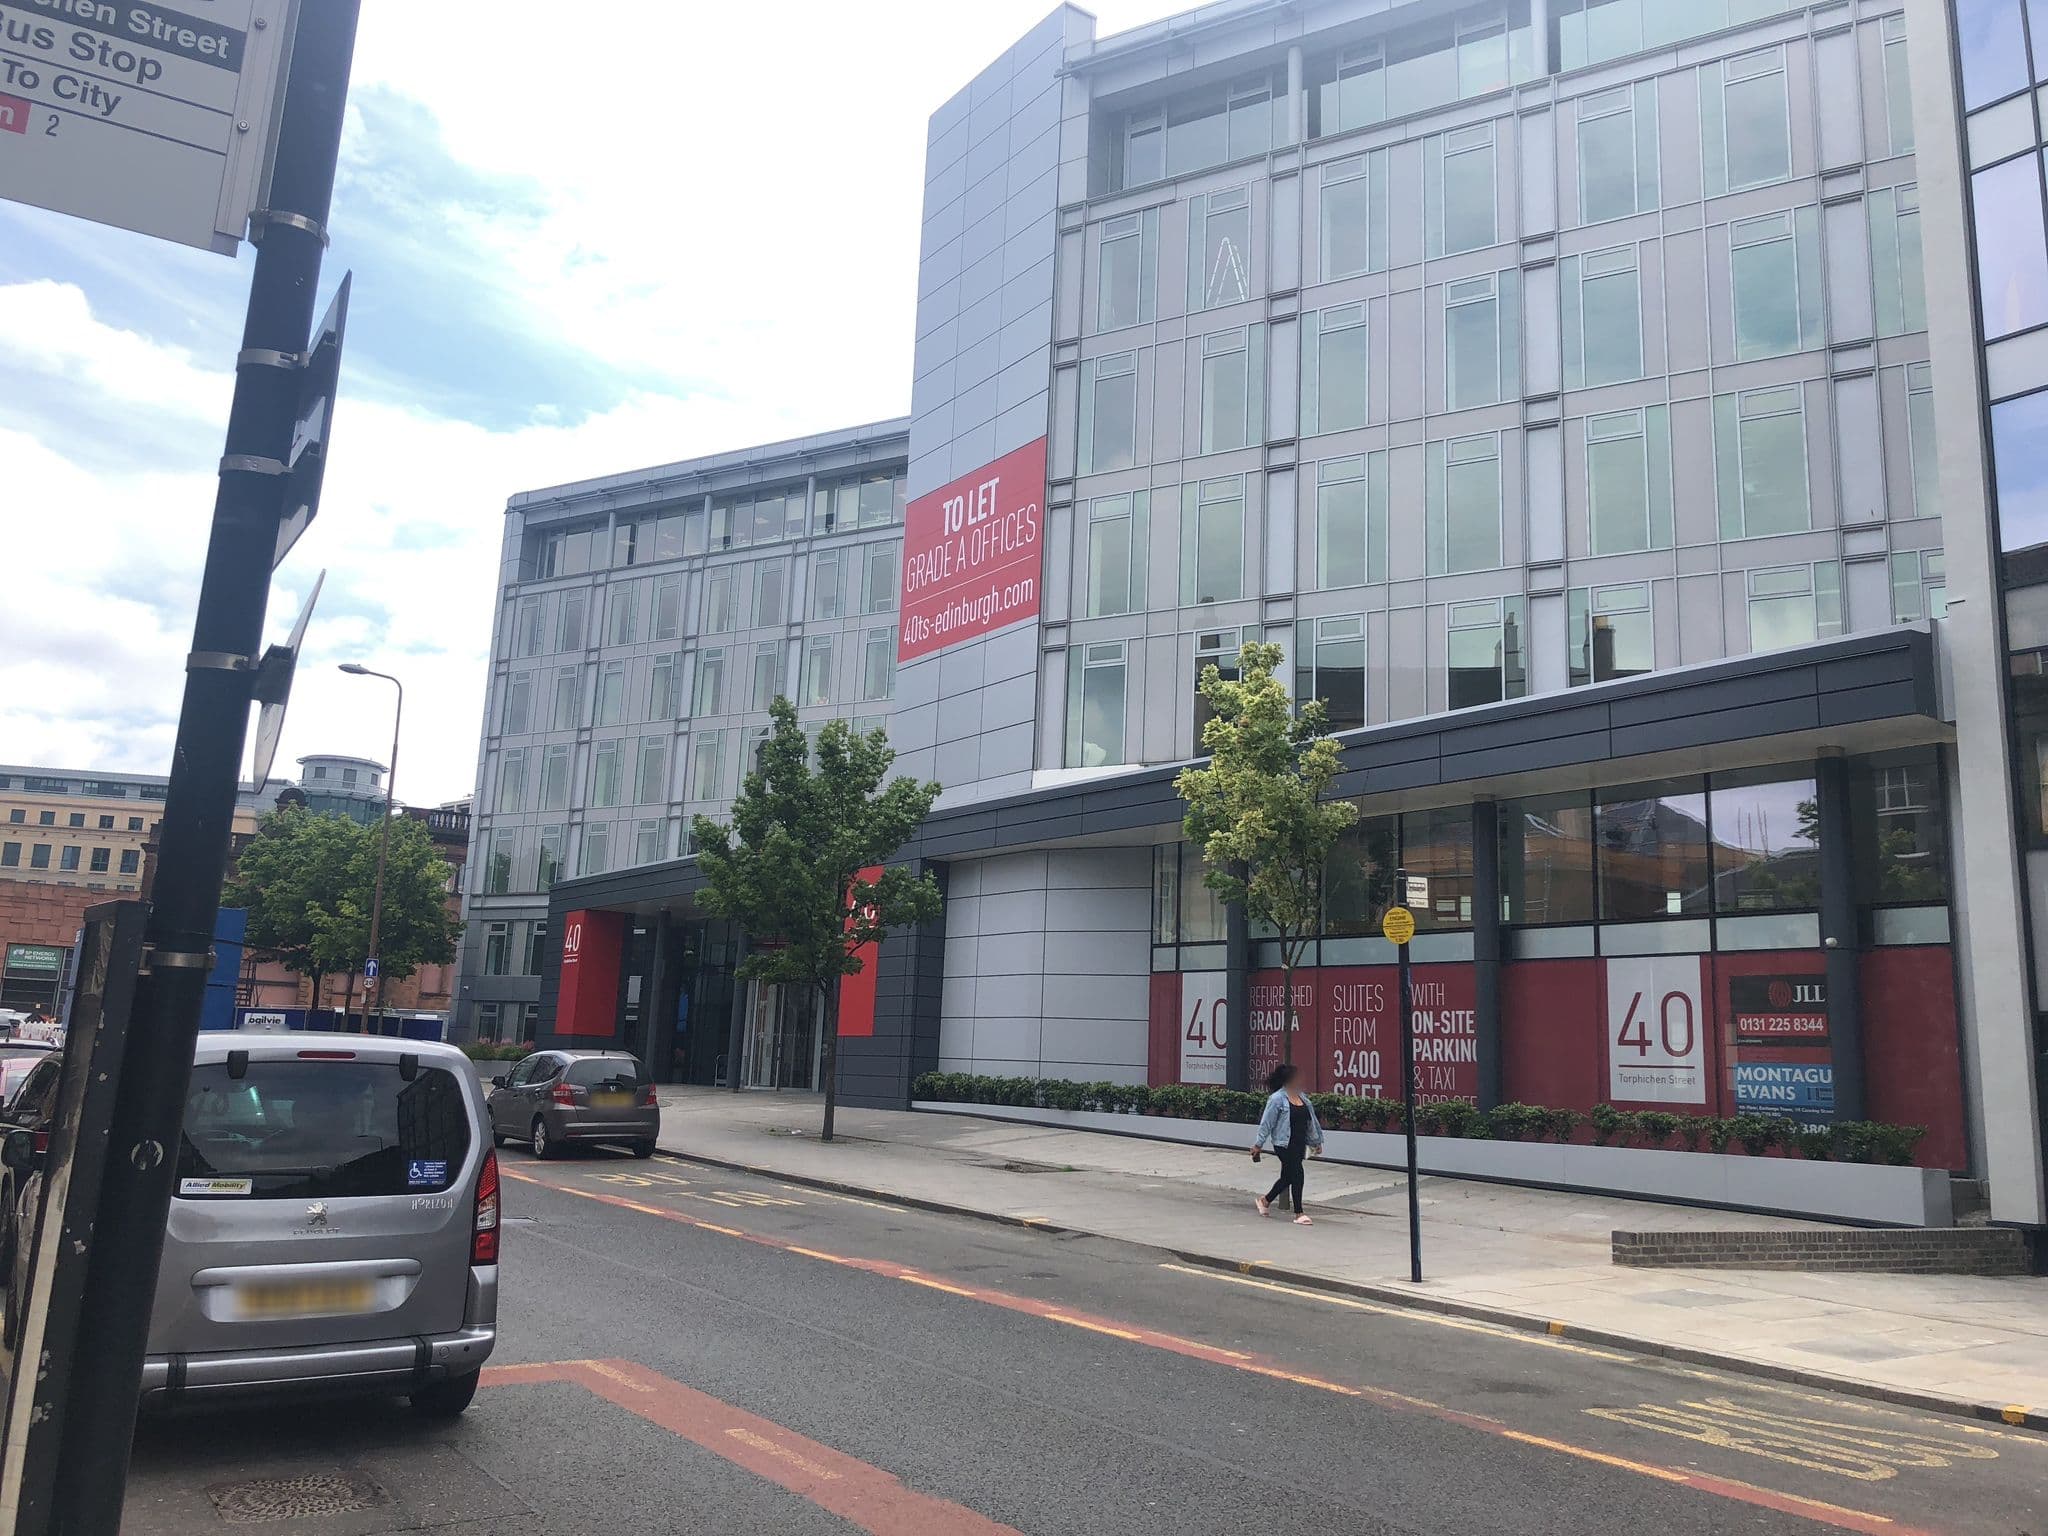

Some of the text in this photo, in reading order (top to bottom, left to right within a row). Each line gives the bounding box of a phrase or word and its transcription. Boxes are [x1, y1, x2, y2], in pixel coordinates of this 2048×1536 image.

[0, 10, 162, 84] us Stop
[128, 9, 229, 59] Street
[3, 58, 122, 116] To City
[46, 114, 60, 137] 2
[943, 477, 1000, 536] TO LET
[906, 504, 1036, 593] GRADE A OFFICES
[904, 578, 1033, 645] 40ts-edinburgh.com
[565, 924, 580, 952] 40
[1250, 985, 1312, 1007] REFURBSHED
[1334, 984, 1384, 1012] SUITES
[1411, 983, 1445, 1006] WITH
[1792, 984, 1826, 1002] JLL
[1334, 1017, 1376, 1045] FROM
[1412, 1010, 1475, 1034] ON-SITE
[1618, 991, 1694, 1057] 40
[1740, 1018, 1824, 1032] 0131 225 8344
[1250, 1034, 1278, 1056] OFFICE
[1334, 1050, 1380, 1078] 3,400
[1738, 1067, 1832, 1084] MONTAGU
[1414, 1066, 1456, 1090] & TAXI
[1618, 1074, 1696, 1084] Torphichen Street
[1738, 1084, 1796, 1100] EVANS
[412, 1198, 453, 1210] HORIZON
[1580, 1396, 2000, 1482] BUS
